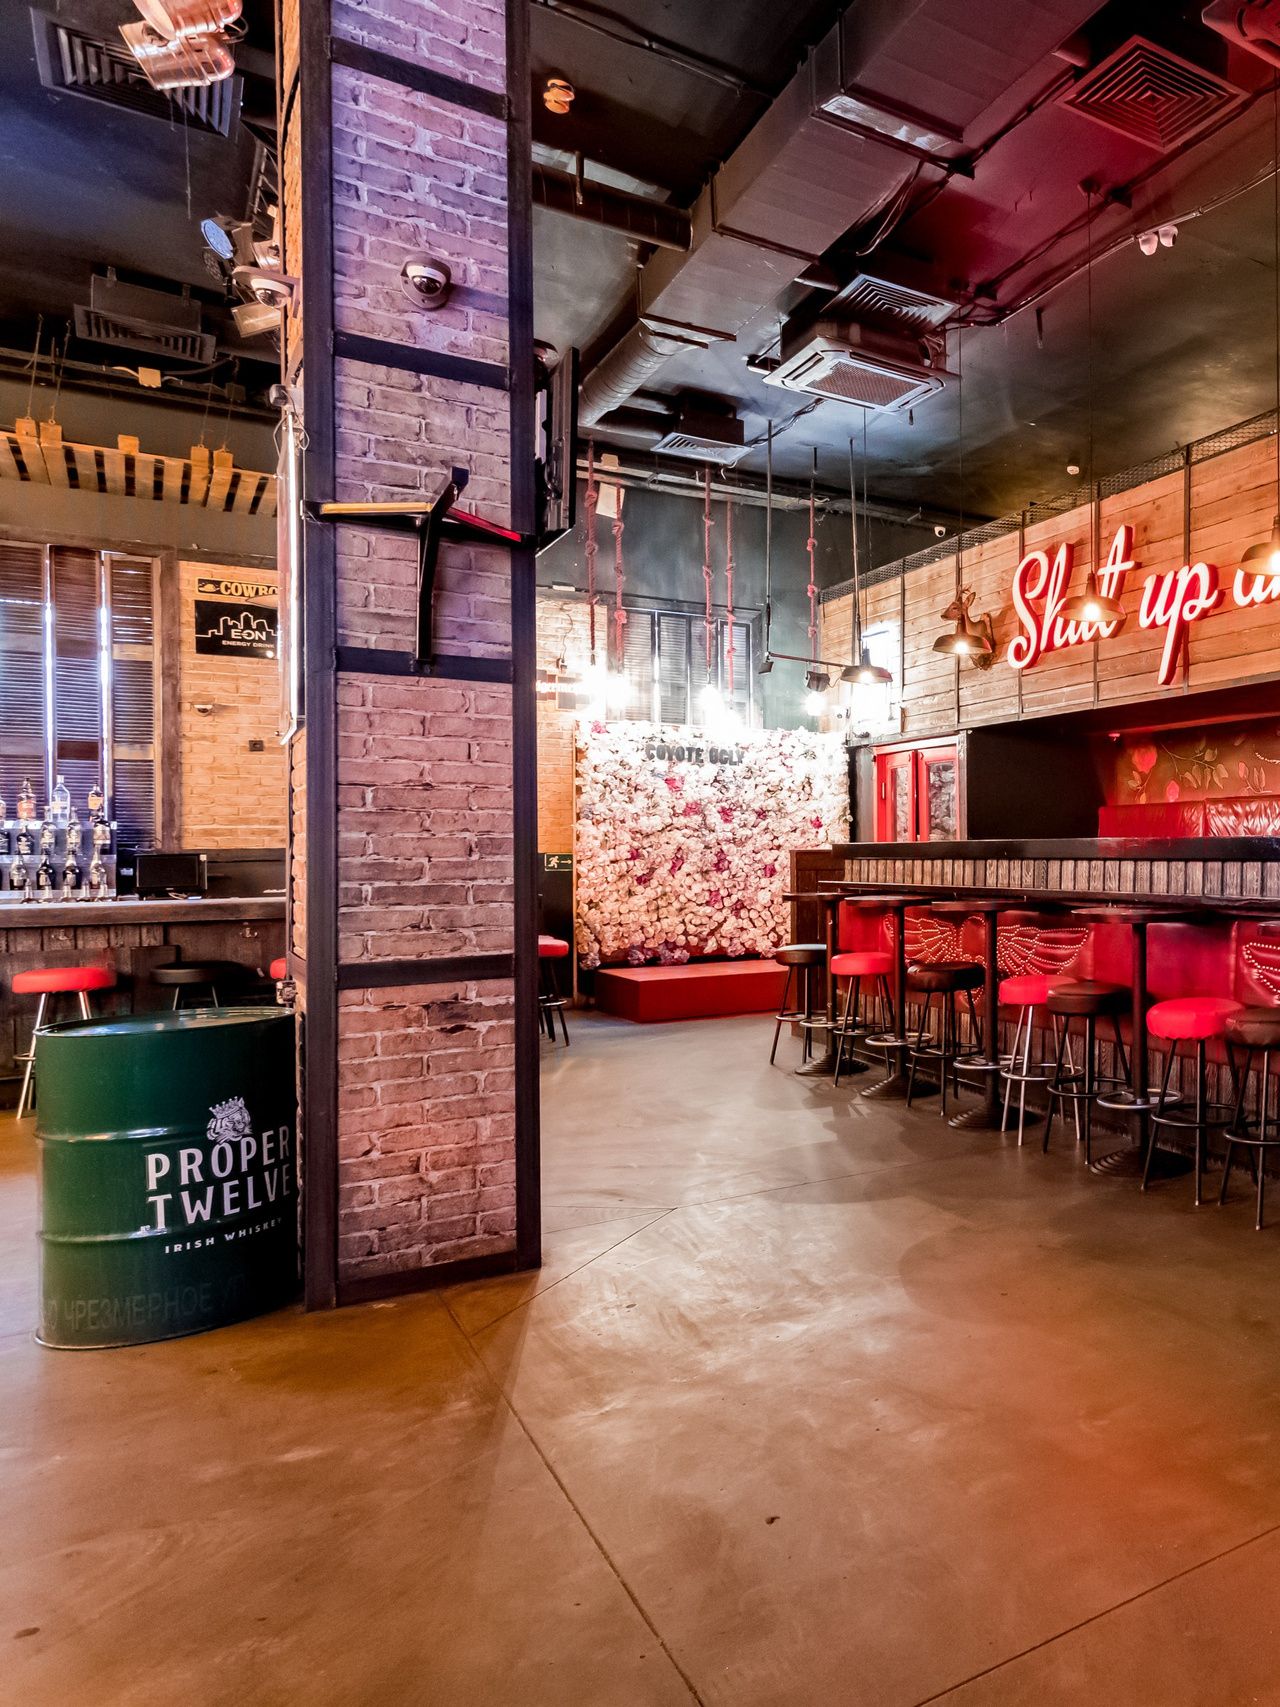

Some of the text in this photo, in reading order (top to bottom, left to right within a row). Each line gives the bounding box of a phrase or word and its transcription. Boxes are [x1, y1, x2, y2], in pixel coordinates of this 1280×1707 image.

[221, 639, 276, 649] ENERGY DRINK
[230, 628, 267, 641] EON
[1137, 561, 1220, 686] up
[645, 743, 745, 766] COYOTE UGLY
[146, 1125, 290, 1192] PROPER
[146, 1163, 291, 1230] TWELVE
[164, 1216, 282, 1254] IRISH WHISKEY
[63, 1282, 213, 1332] ЧРЕЗМЕРНОЕ
